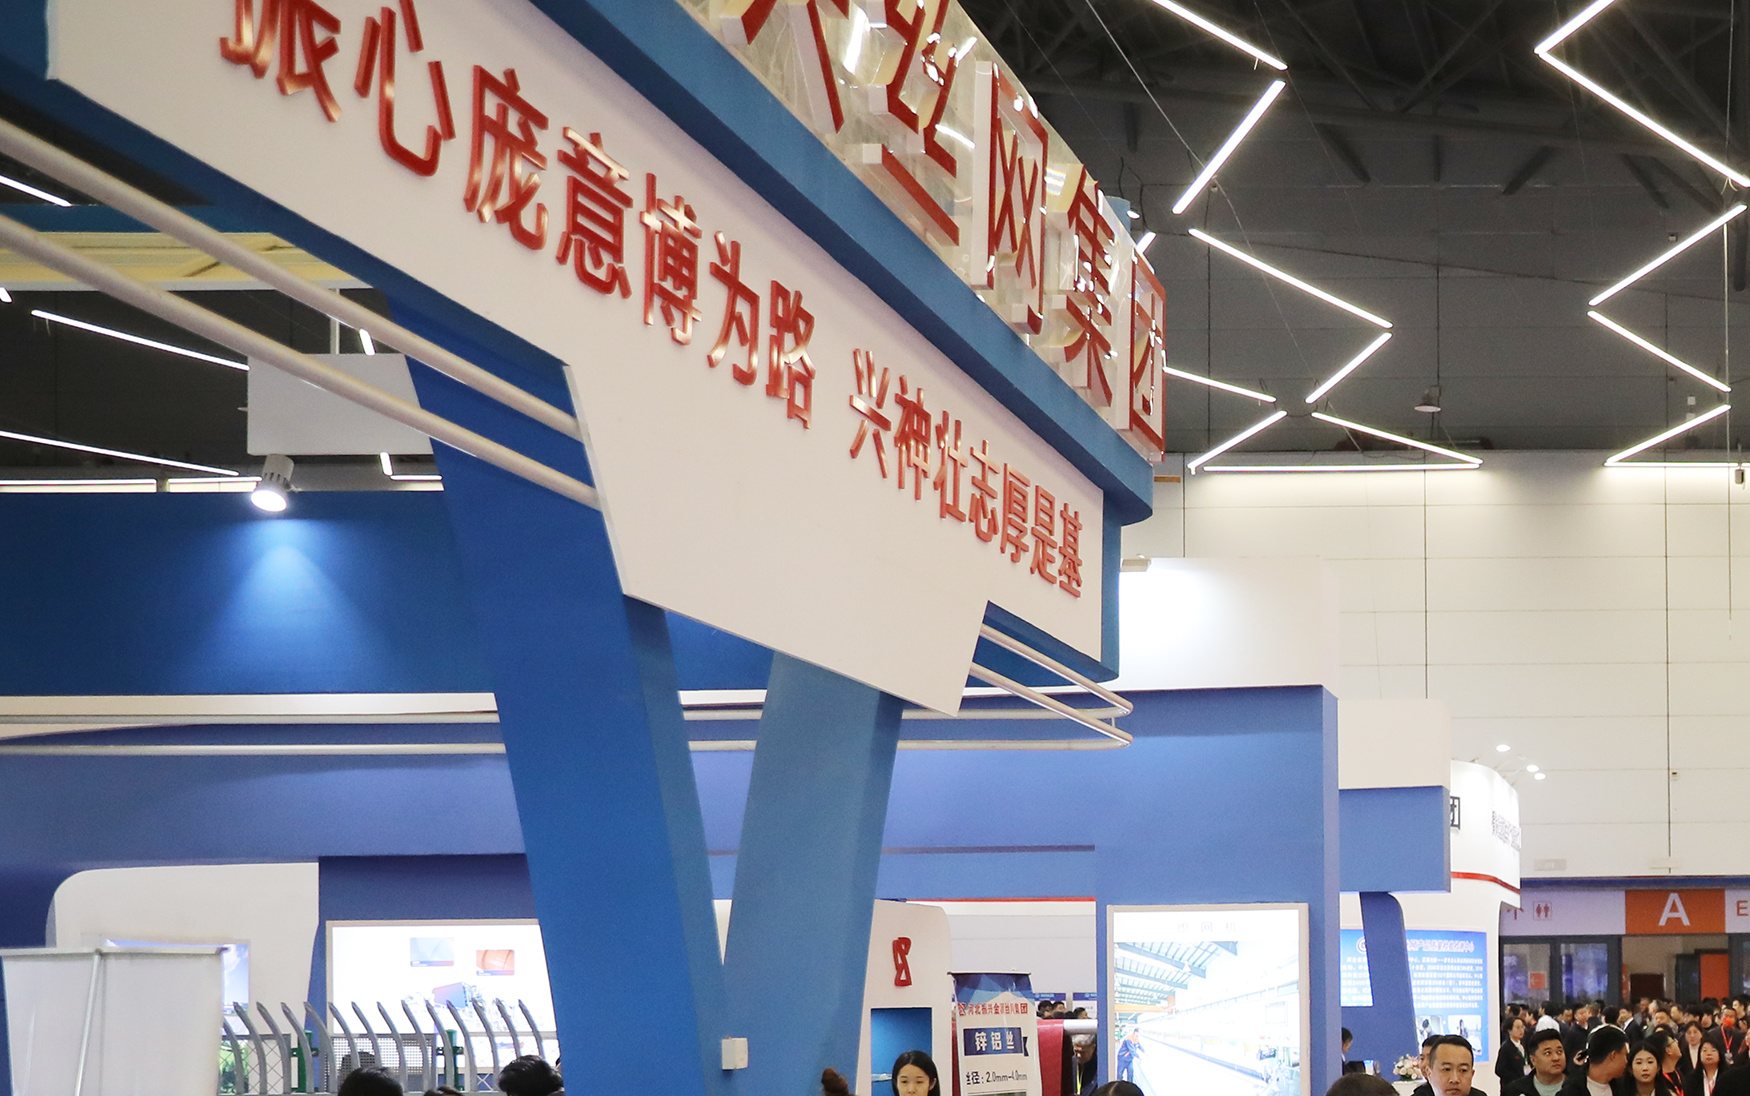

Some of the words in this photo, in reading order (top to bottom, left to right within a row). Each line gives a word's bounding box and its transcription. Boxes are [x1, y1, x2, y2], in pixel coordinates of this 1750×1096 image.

[849, 347, 1084, 600] 兴神壮志厚是基
[1658, 893, 1690, 926] A
